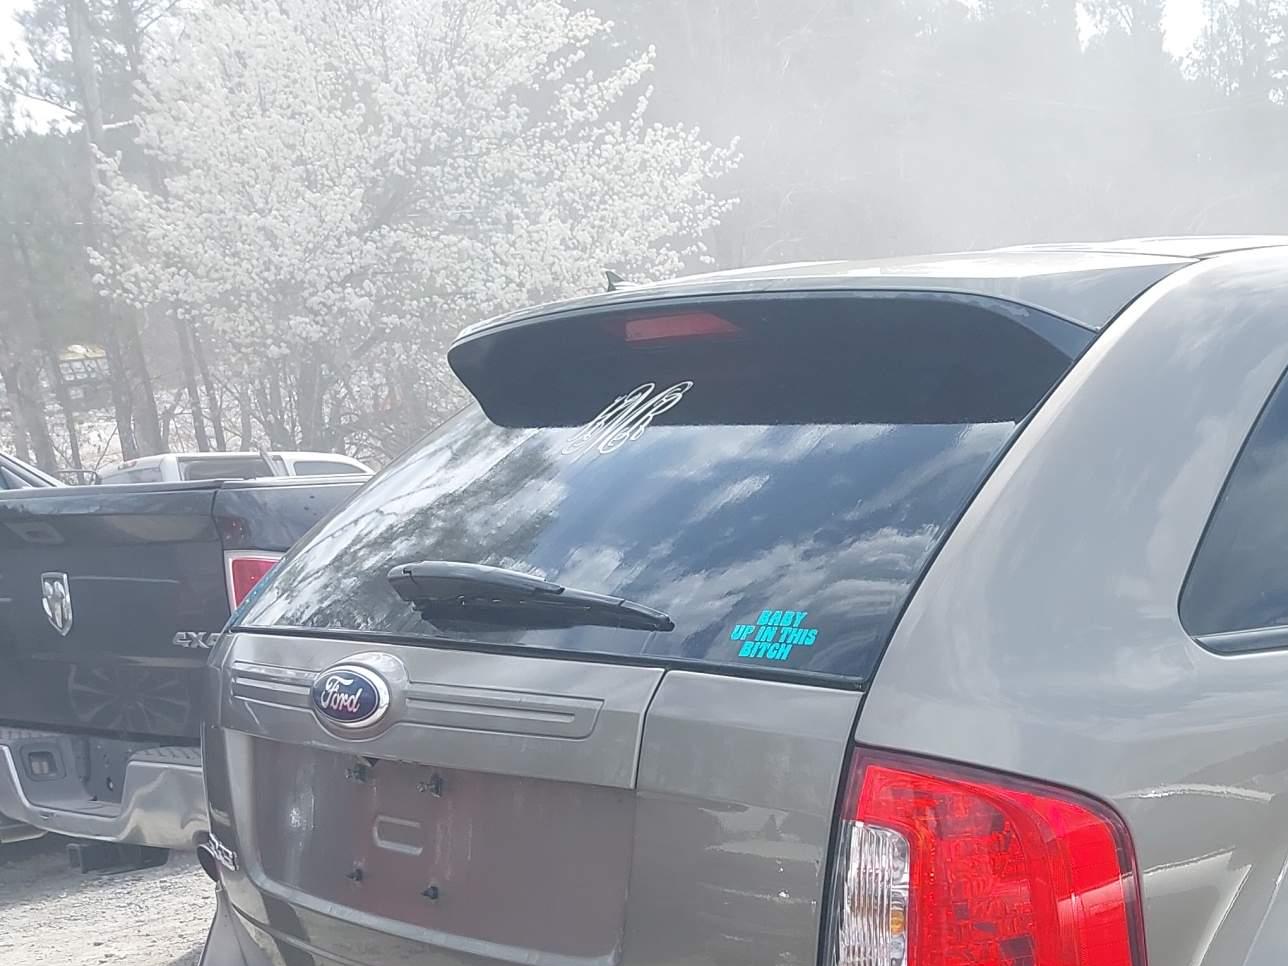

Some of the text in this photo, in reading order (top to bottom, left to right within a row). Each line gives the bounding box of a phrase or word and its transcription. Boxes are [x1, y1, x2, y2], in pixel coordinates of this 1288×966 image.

[757, 610, 808, 627] BABY
[730, 624, 818, 646] UP IN THIS
[738, 641, 792, 660] BITCH
[320, 674, 363, 713] Ford
